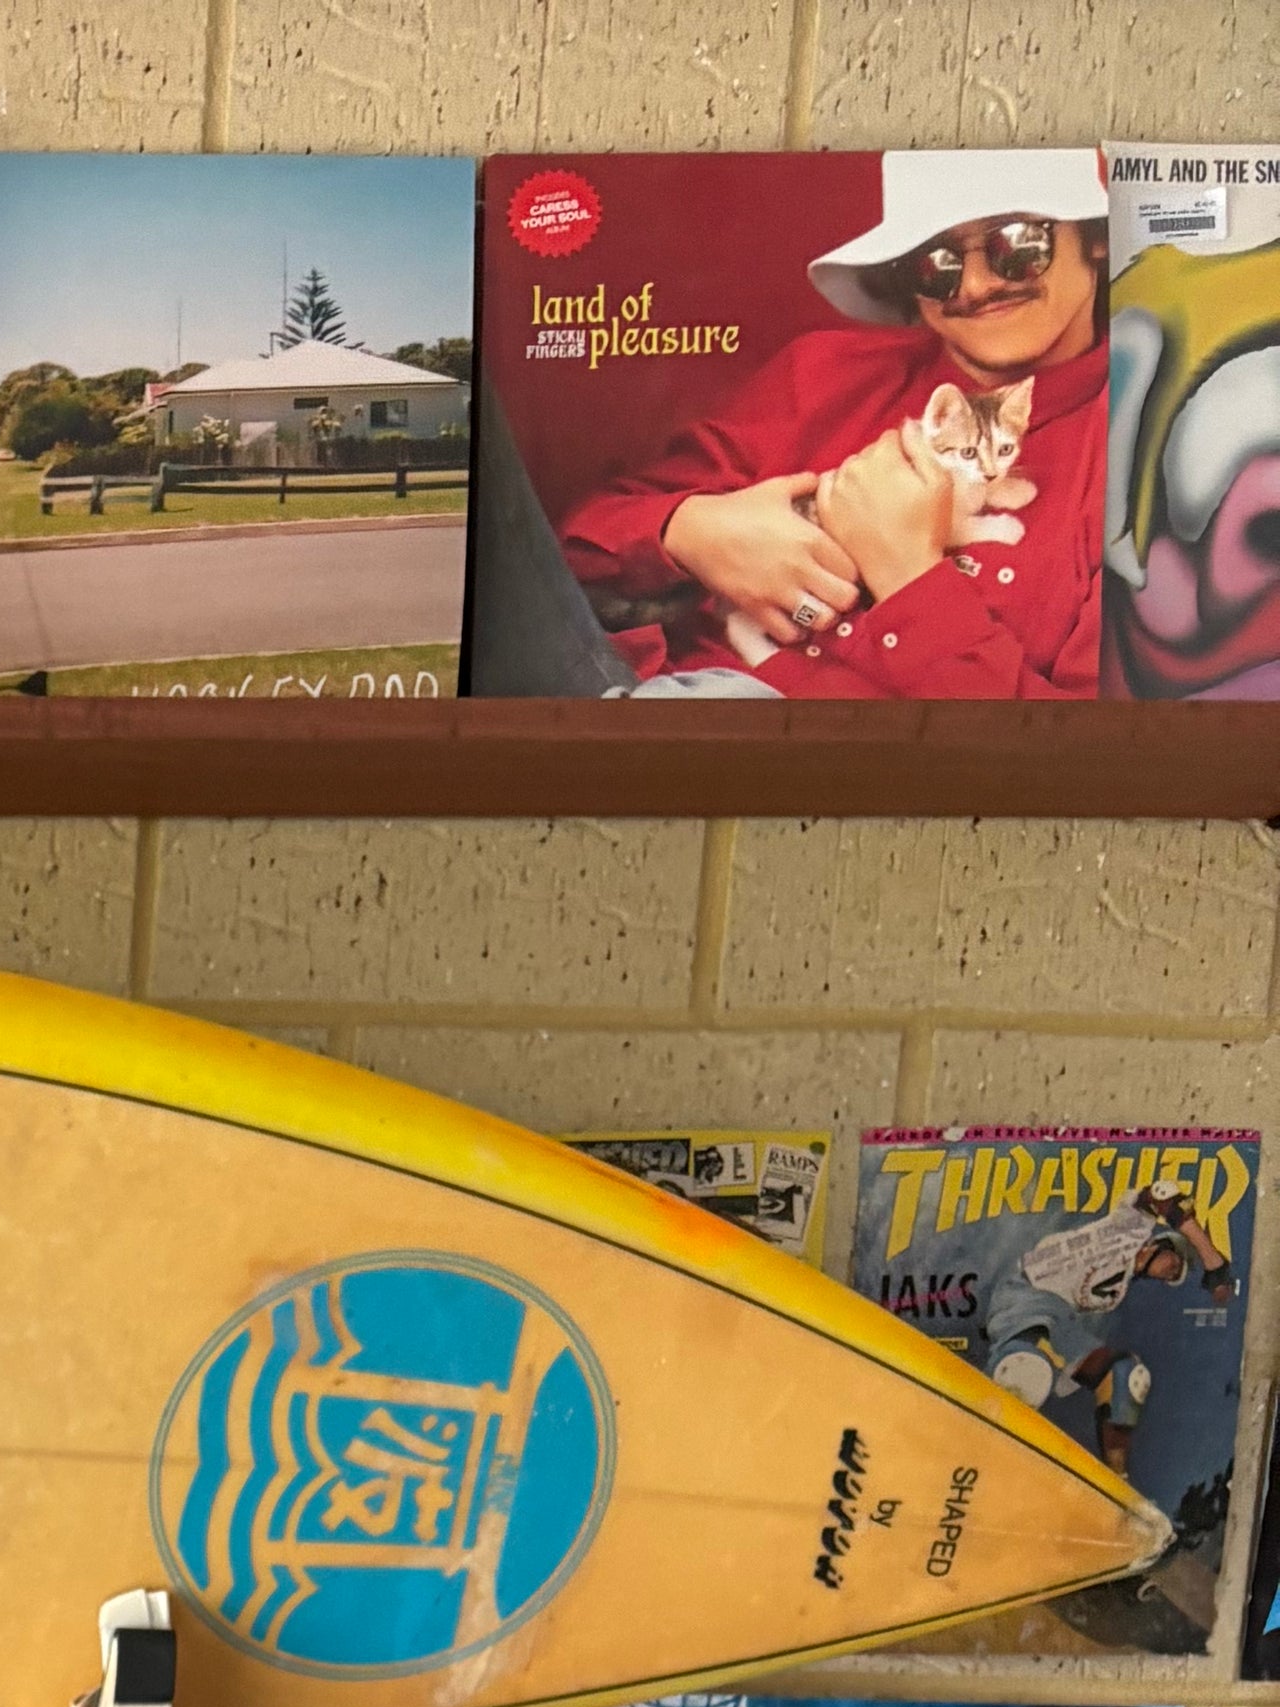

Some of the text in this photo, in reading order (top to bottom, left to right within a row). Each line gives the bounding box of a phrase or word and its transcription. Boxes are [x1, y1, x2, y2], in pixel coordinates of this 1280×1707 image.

[1112, 158, 1162, 182] AMYL
[1168, 159, 1207, 182] AND
[1213, 160, 1249, 183] THE
[521, 209, 592, 229] YOUR SOUL
[529, 199, 579, 216] CARESS
[531, 282, 654, 325] land of
[525, 342, 586, 359] FINGERS
[537, 329, 586, 345] STICKY
[589, 316, 740, 369] pleasure
[880, 1144, 1250, 1264] THRASHER
[869, 1499, 902, 1529] by
[926, 1466, 979, 1577] SHAPED
